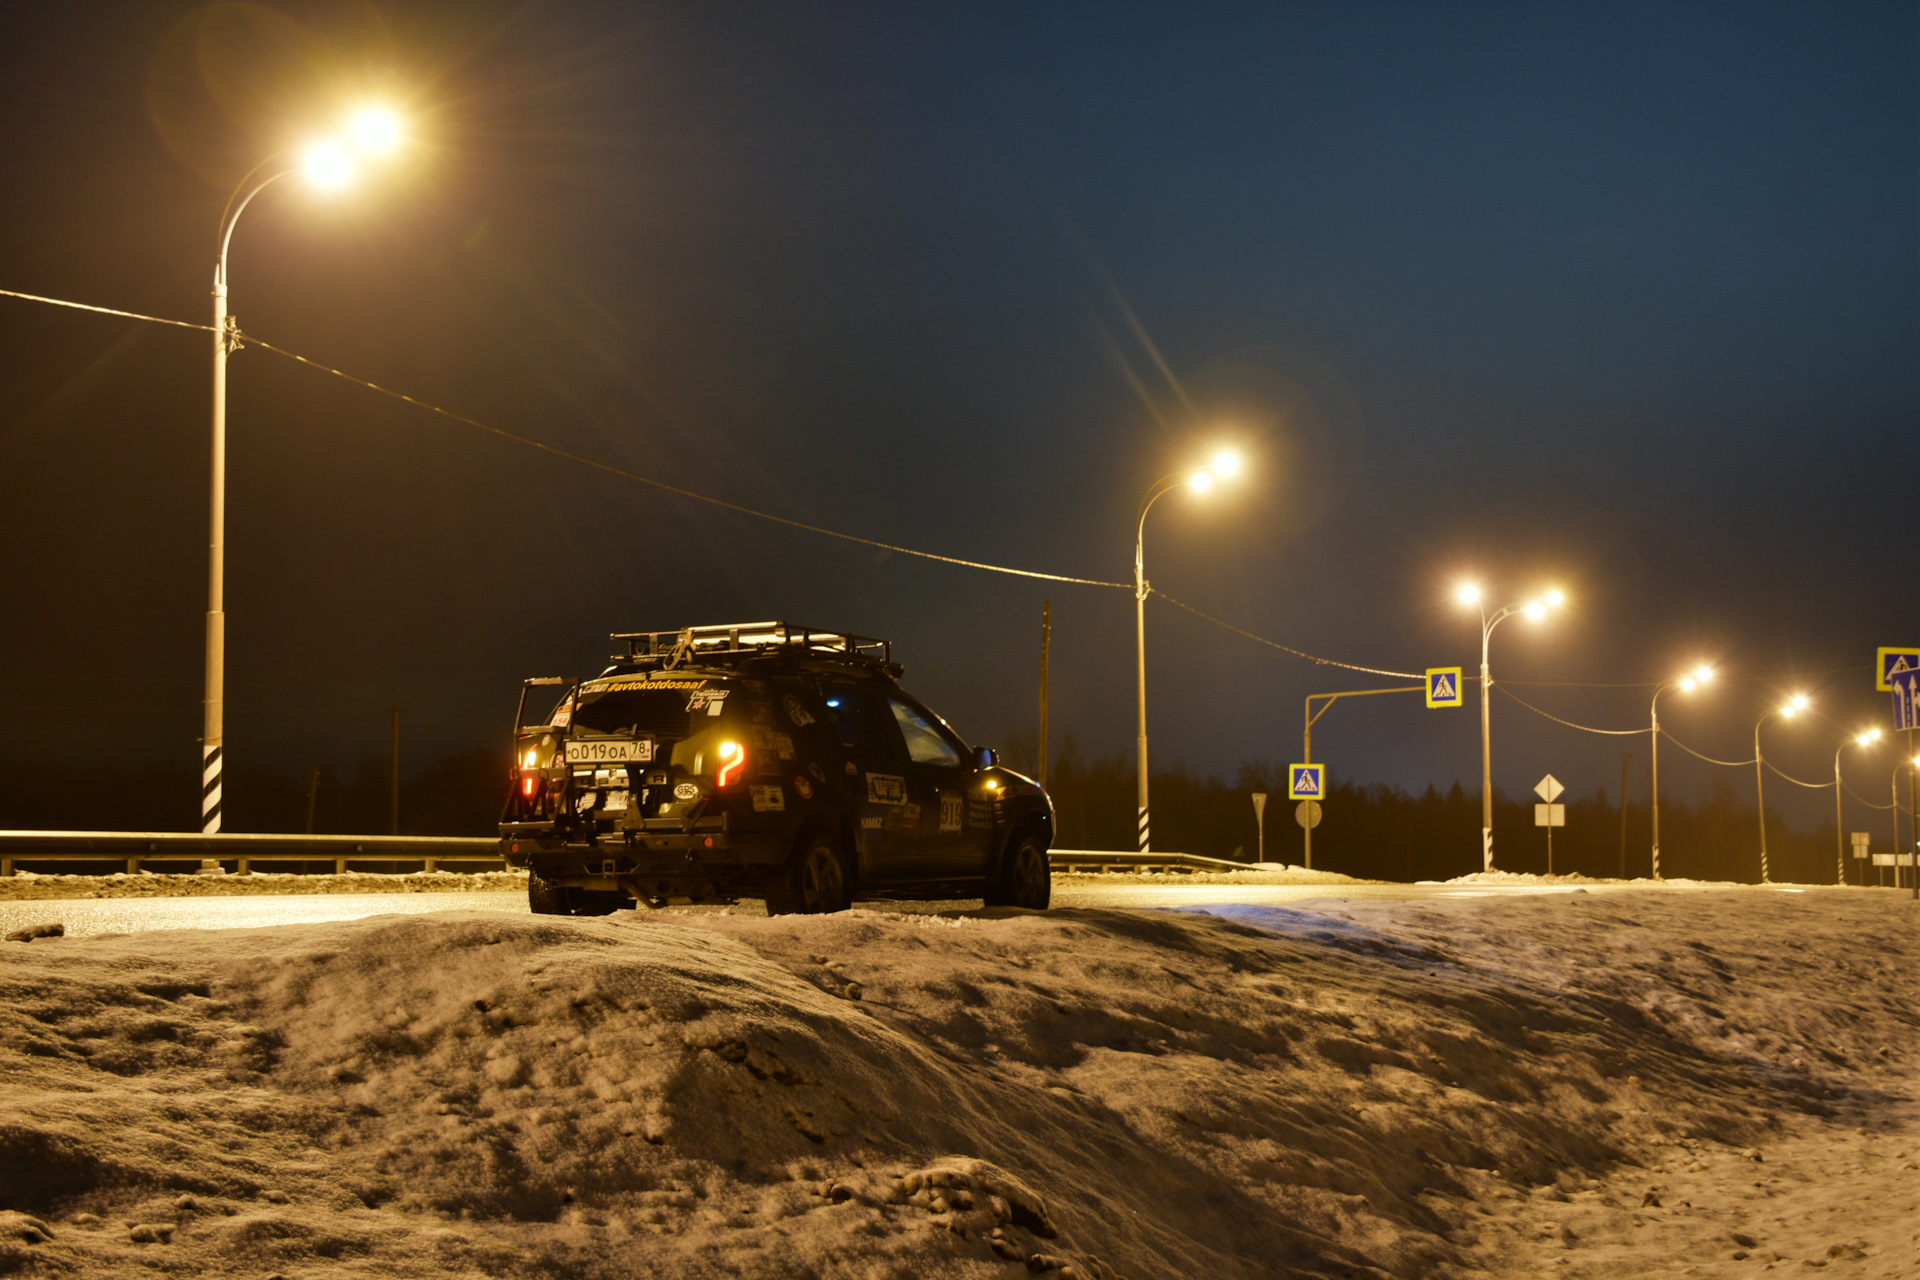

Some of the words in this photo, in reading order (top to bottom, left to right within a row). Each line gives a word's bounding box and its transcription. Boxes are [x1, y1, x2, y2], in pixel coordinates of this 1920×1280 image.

[607, 679, 708, 693] #avtokotdosaaf
[631, 742, 646, 754] 78
[941, 801, 962, 825] 919
